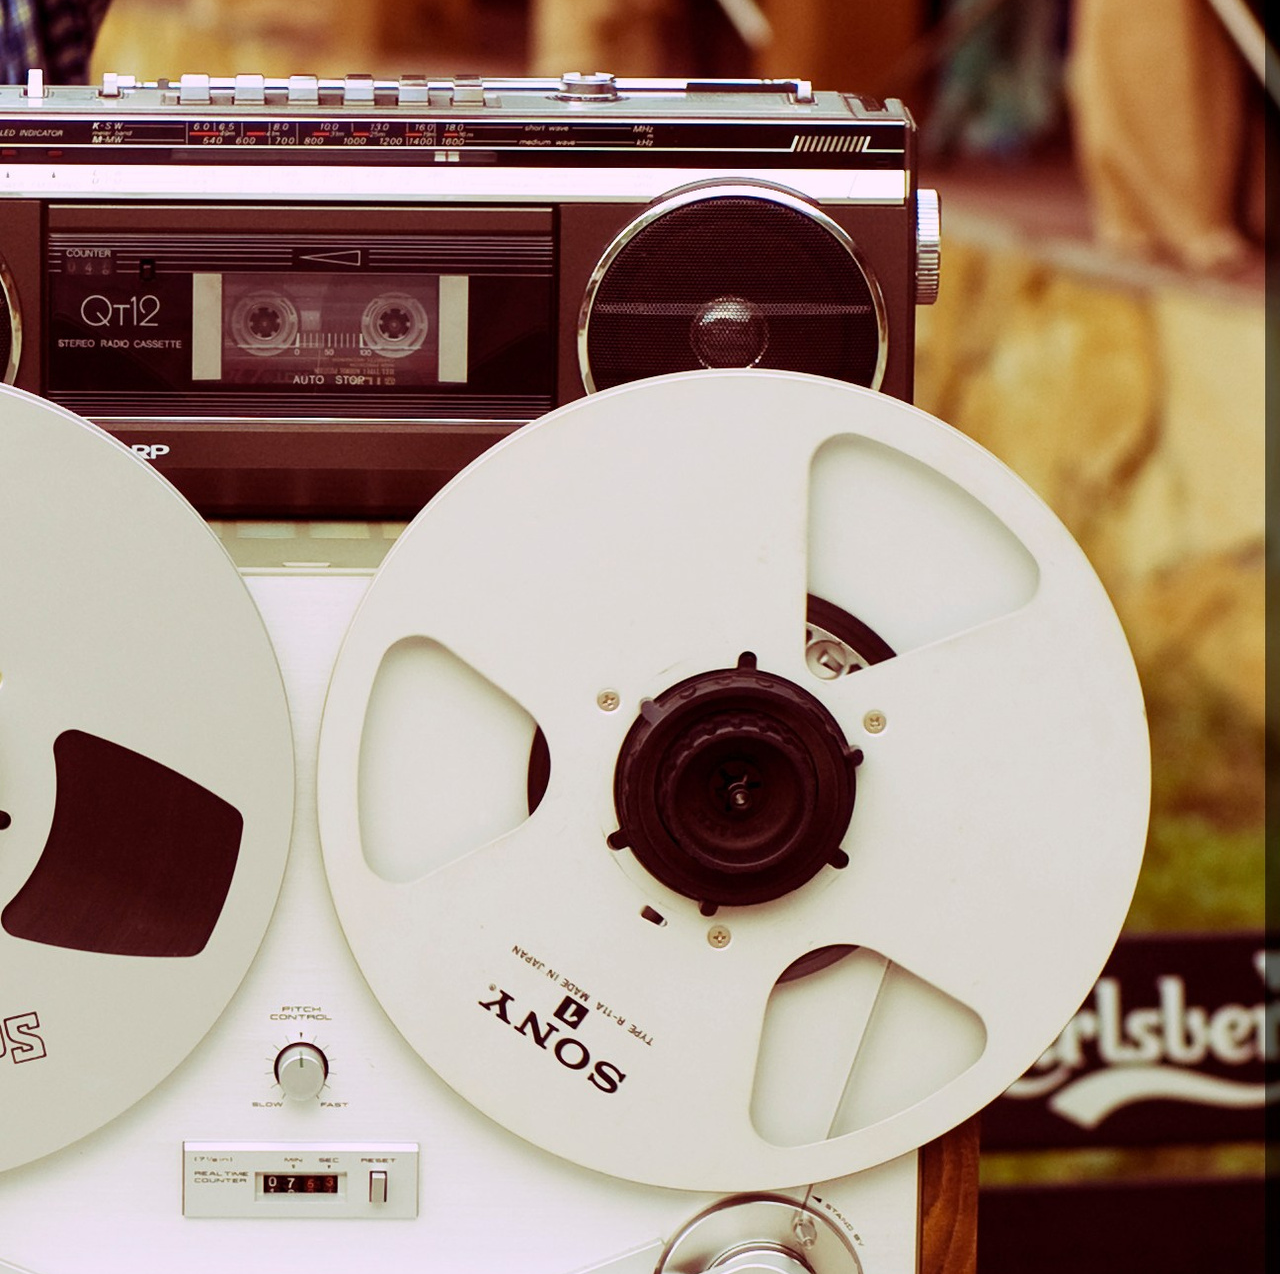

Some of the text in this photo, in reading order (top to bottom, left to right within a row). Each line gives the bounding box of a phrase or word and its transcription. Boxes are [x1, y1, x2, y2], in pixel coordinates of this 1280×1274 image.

[193, 123, 210, 131] 6.0
[273, 123, 289, 131] 8.0
[320, 123, 339, 131] 10.0
[371, 123, 389, 131] 13.0
[415, 123, 434, 131] 16.0
[633, 125, 654, 133] MHz
[0, 129, 64, 137] LED INDICATOR
[202, 137, 465, 145] 540 600 700 800 1000 1200 1400 1600
[66, 249, 111, 258] COUNTER
[81, 295, 160, 326] QT12
[58, 339, 182, 349] STEREO RADIO CASSETTE
[293, 375, 324, 385] AUTO
[335, 375, 365, 385] STOP
[511, 945, 654, 1046] TYPE R-11A MADE IN JAPAN
[478, 989, 627, 1094] SONY
[825, 1203, 864, 1246] STAND BY
